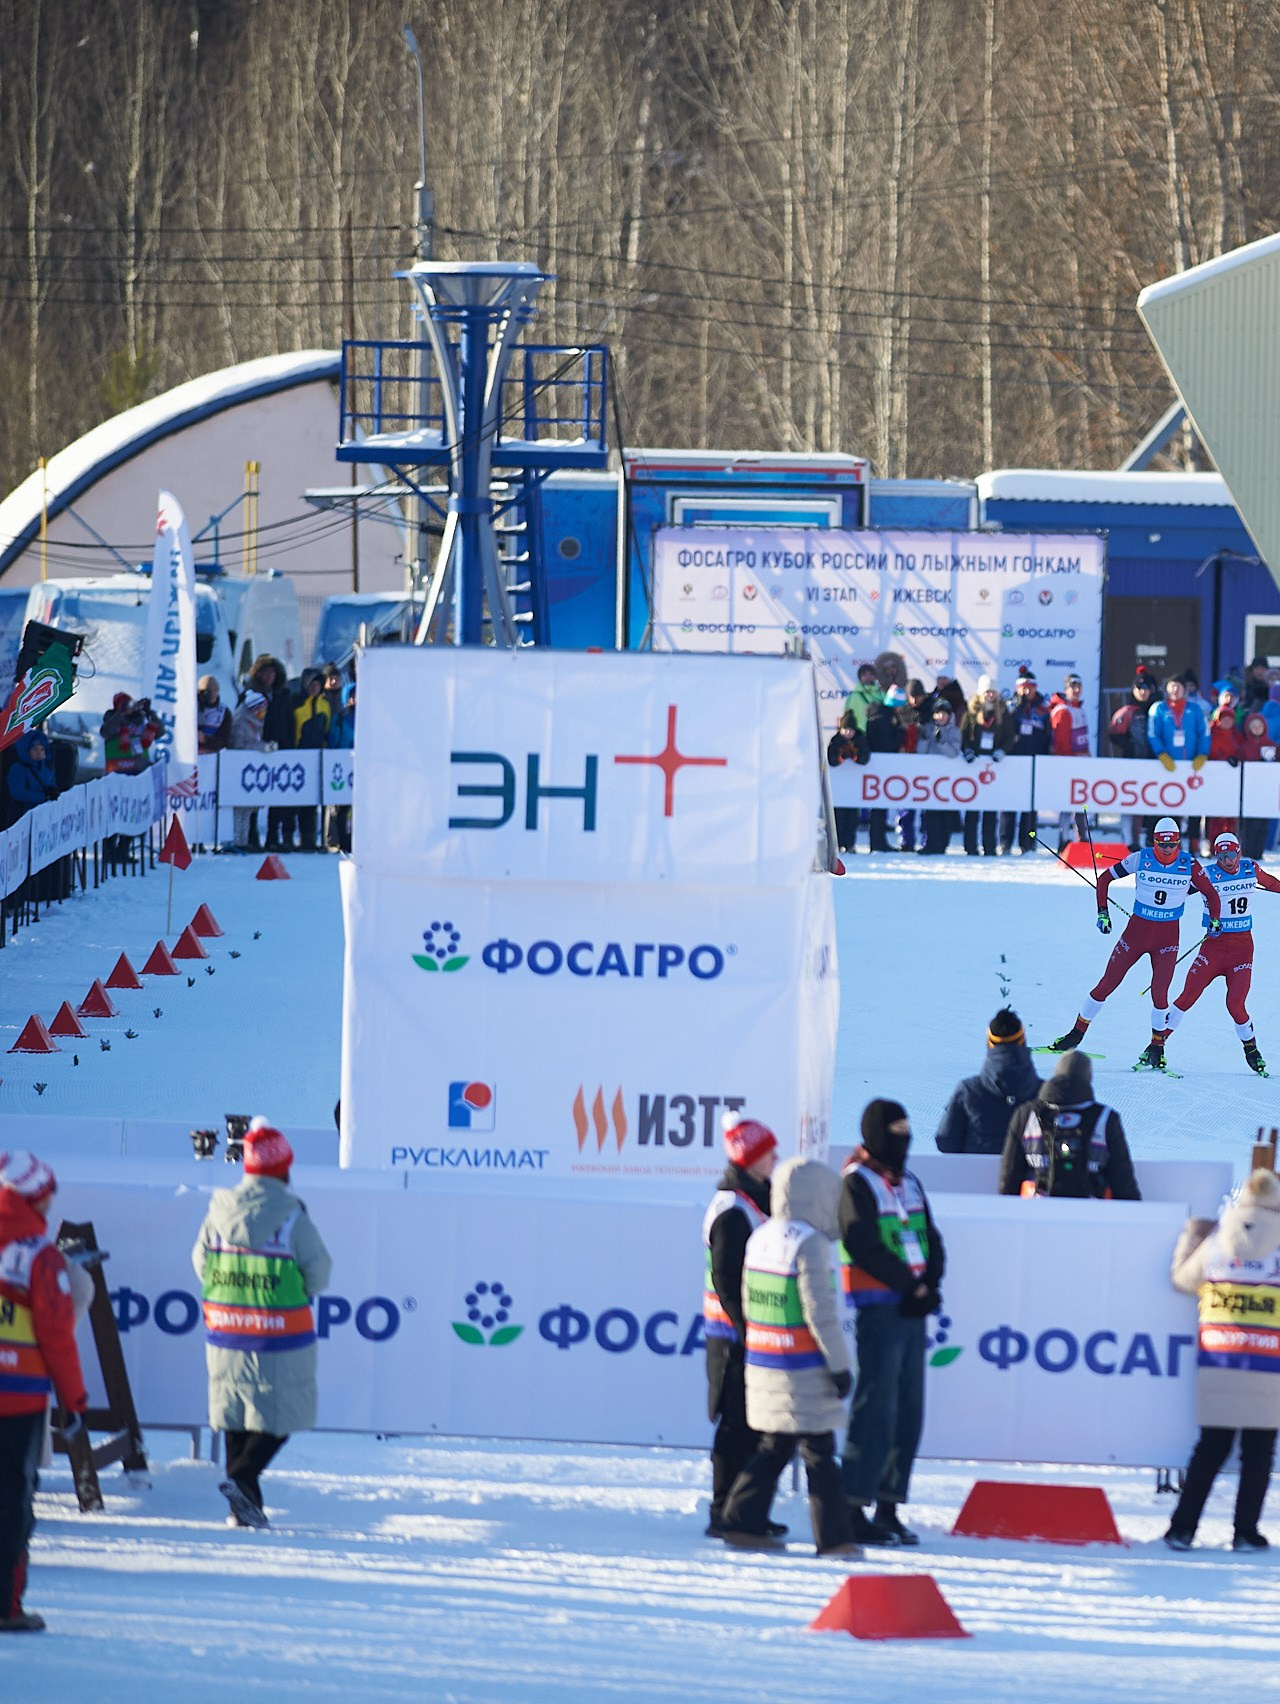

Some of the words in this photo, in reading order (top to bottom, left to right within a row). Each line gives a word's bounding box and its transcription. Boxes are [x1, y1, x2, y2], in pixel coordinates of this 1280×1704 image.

[678, 549, 757, 568] ФОСАГРО
[762, 551, 816, 569] КУБОК
[822, 553, 888, 570] РОССИИ
[894, 554, 916, 570] ПО
[921, 554, 1007, 572] ЛЫЖНЫМ
[1013, 556, 1081, 573] ГОНКАМ
[806, 587, 820, 600] VI
[824, 588, 857, 601] ЭТАП
[893, 589, 952, 603] ИЖЕВСК
[697, 624, 757, 634] ФОСАГРО
[802, 625, 859, 636] ФОСАГРО
[910, 627, 968, 638] ФОСАГРО
[1018, 628, 1076, 639] ФОСАГРО
[241, 762, 305, 793] СОЮЗ
[862, 773, 978, 803] BOSCO
[1070, 778, 1186, 807] BOSCO
[1147, 876, 1188, 886] ФОСАГРО
[1154, 890, 1167, 906] 9
[1228, 897, 1248, 915] 19
[1141, 907, 1175, 919] ИЖЕВСК
[482, 936, 725, 980] ФОСАГРО
[391, 1147, 550, 1170] РУСКЛИМАТ
[1211, 1289, 1276, 1315] СУДЬЯ
